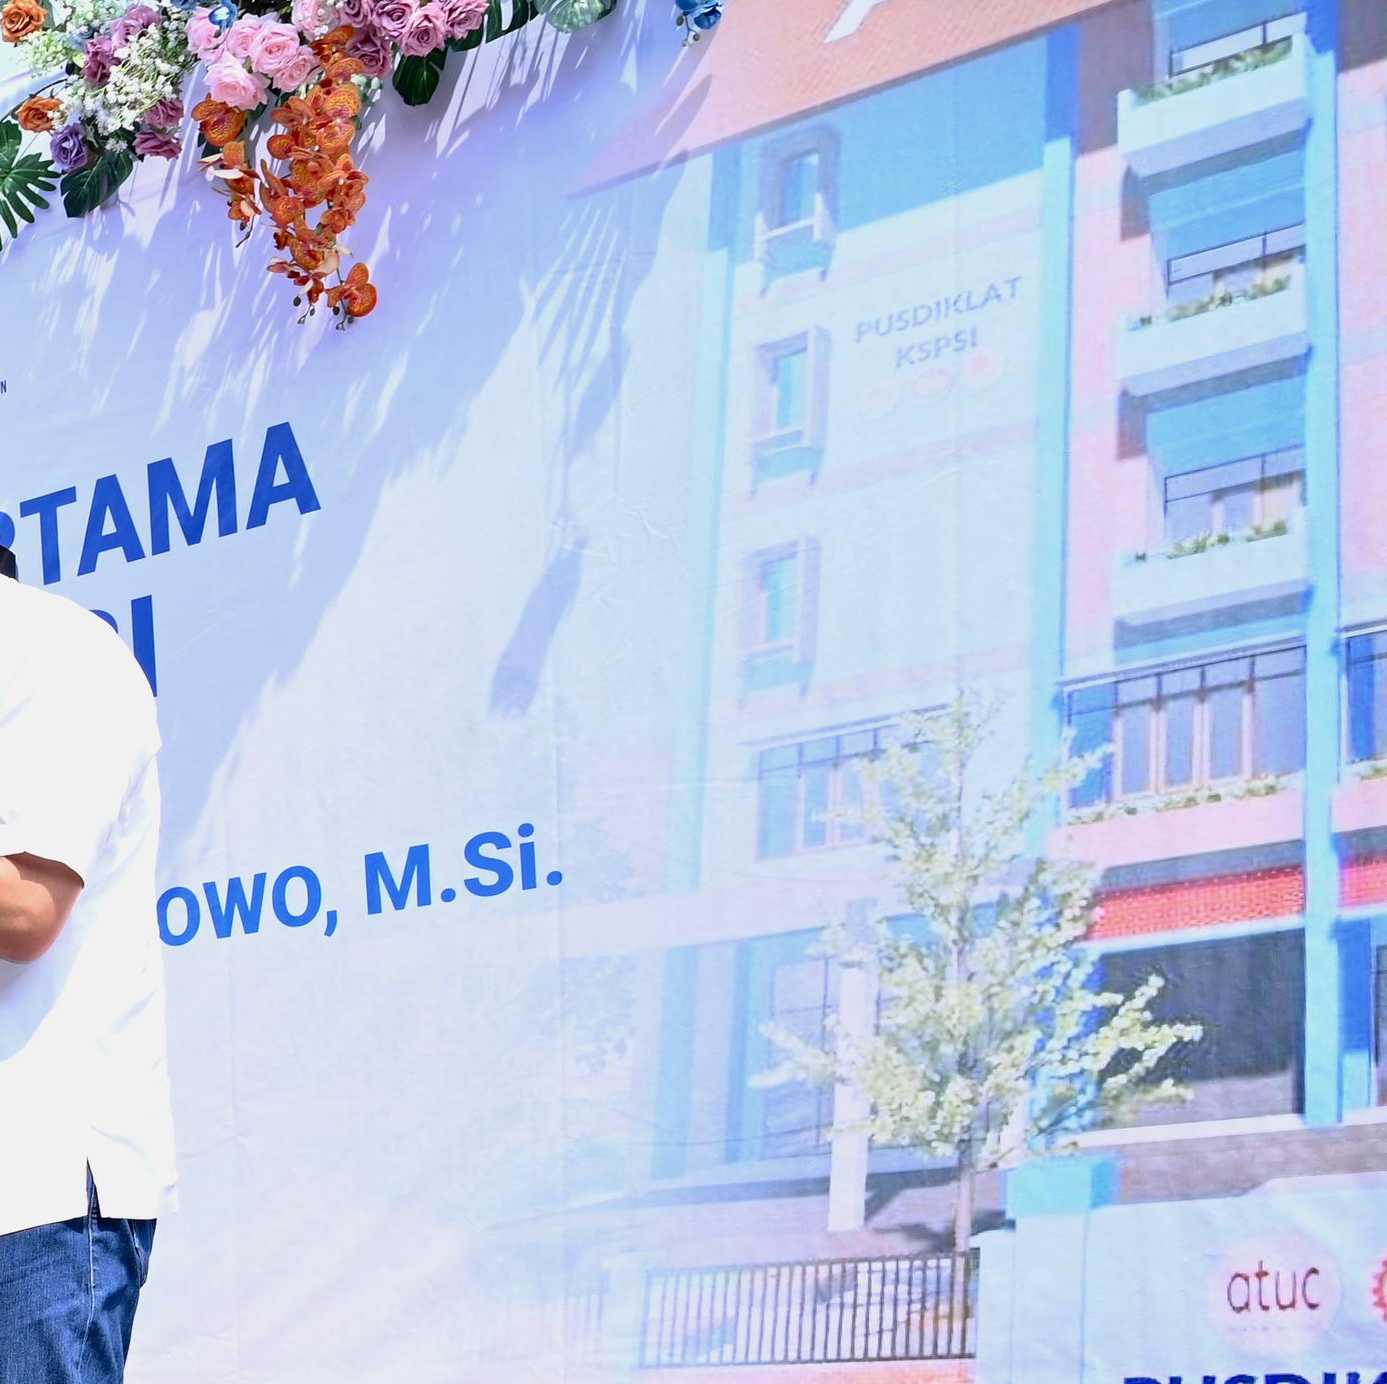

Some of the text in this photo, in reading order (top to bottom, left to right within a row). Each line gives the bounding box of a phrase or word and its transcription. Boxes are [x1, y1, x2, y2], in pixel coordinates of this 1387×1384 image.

[855, 276, 1022, 343] PUSDIKLAT
[895, 326, 978, 369] KSPSI
[156, 865, 338, 947] OWO,
[363, 822, 564, 916] M.Si.
[1227, 1260, 1320, 1314] atuc
